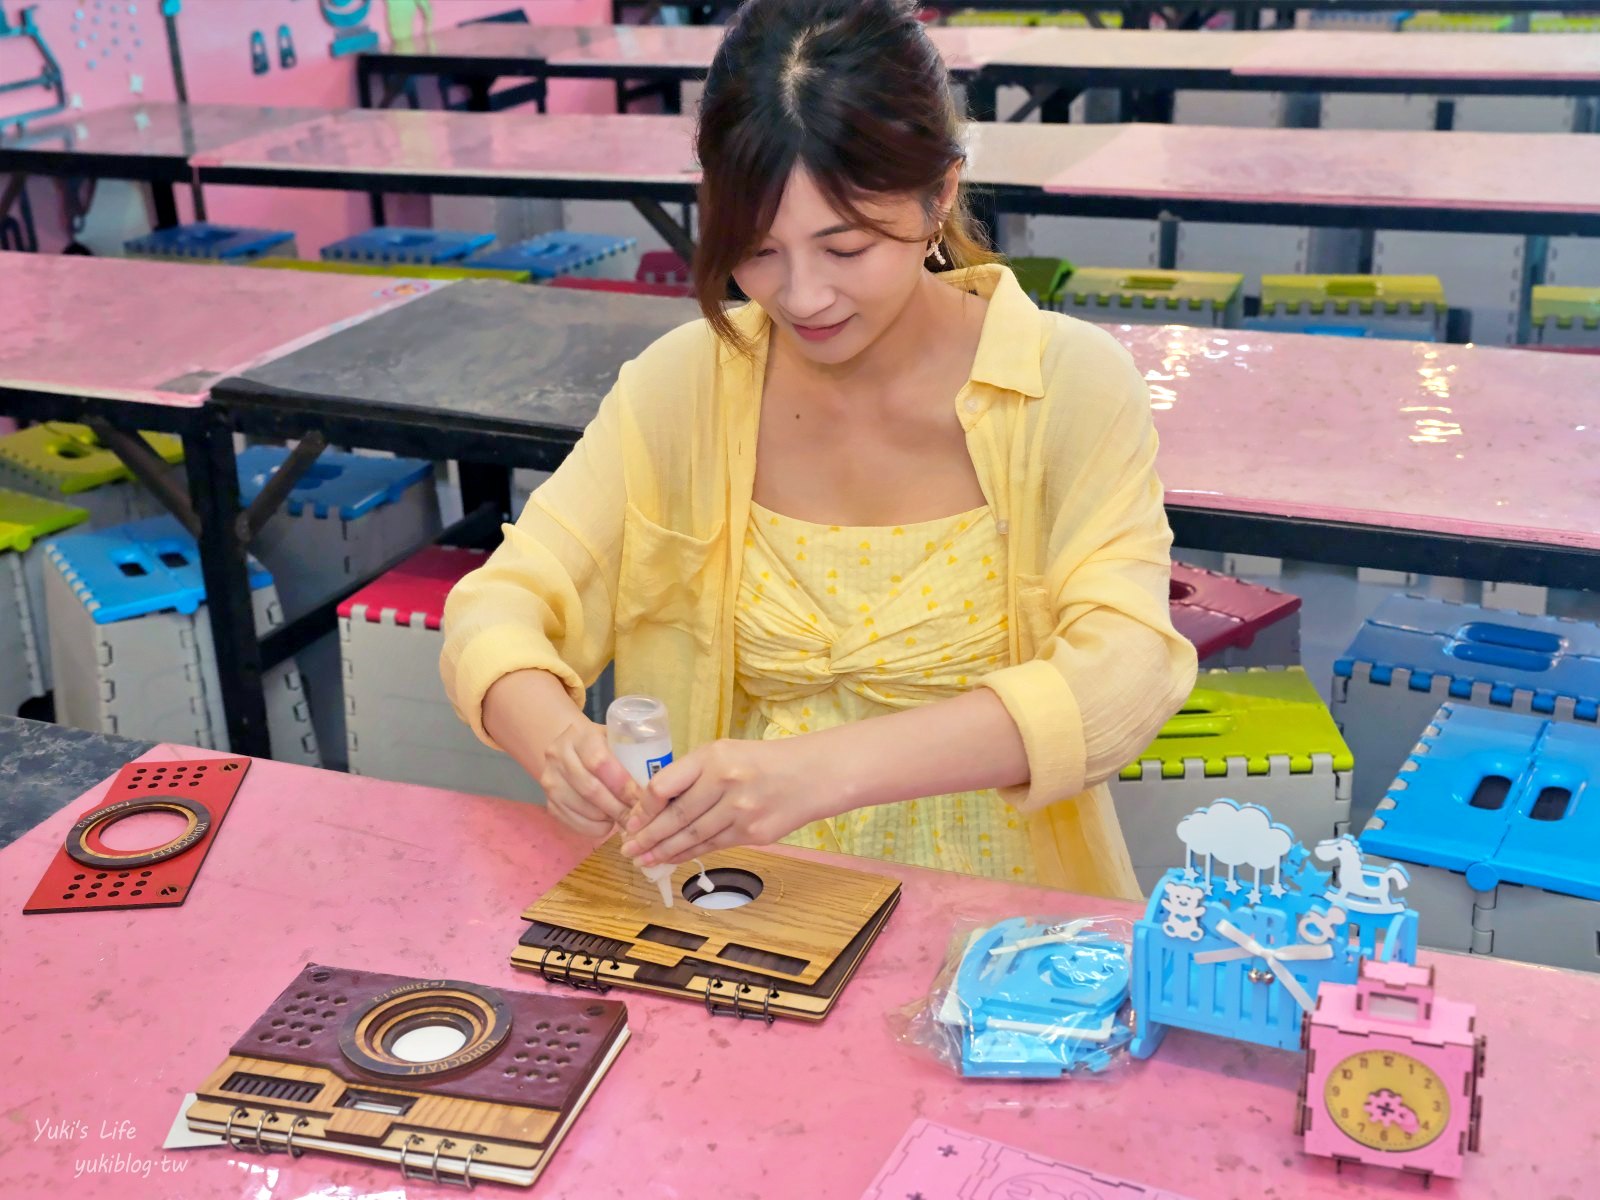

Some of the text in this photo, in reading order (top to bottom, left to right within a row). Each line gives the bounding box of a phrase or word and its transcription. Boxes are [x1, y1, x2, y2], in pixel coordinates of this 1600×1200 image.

[150, 822, 208, 859] YOHOCRAFT
[407, 1039, 499, 1075] YOHOCRAFT
[1383, 1055, 1395, 1067] 12
[1341, 1068, 1353, 1080] 10
[1408, 1063, 1415, 1075] 1
[1424, 1077, 1433, 1090] 2
[1331, 1085, 1341, 1097] 9
[1432, 1100, 1441, 1112] 3
[1340, 1107, 1349, 1119] 8
[1357, 1121, 1366, 1133] 7
[1421, 1120, 1430, 1131] 4
[1380, 1129, 1389, 1141] 6
